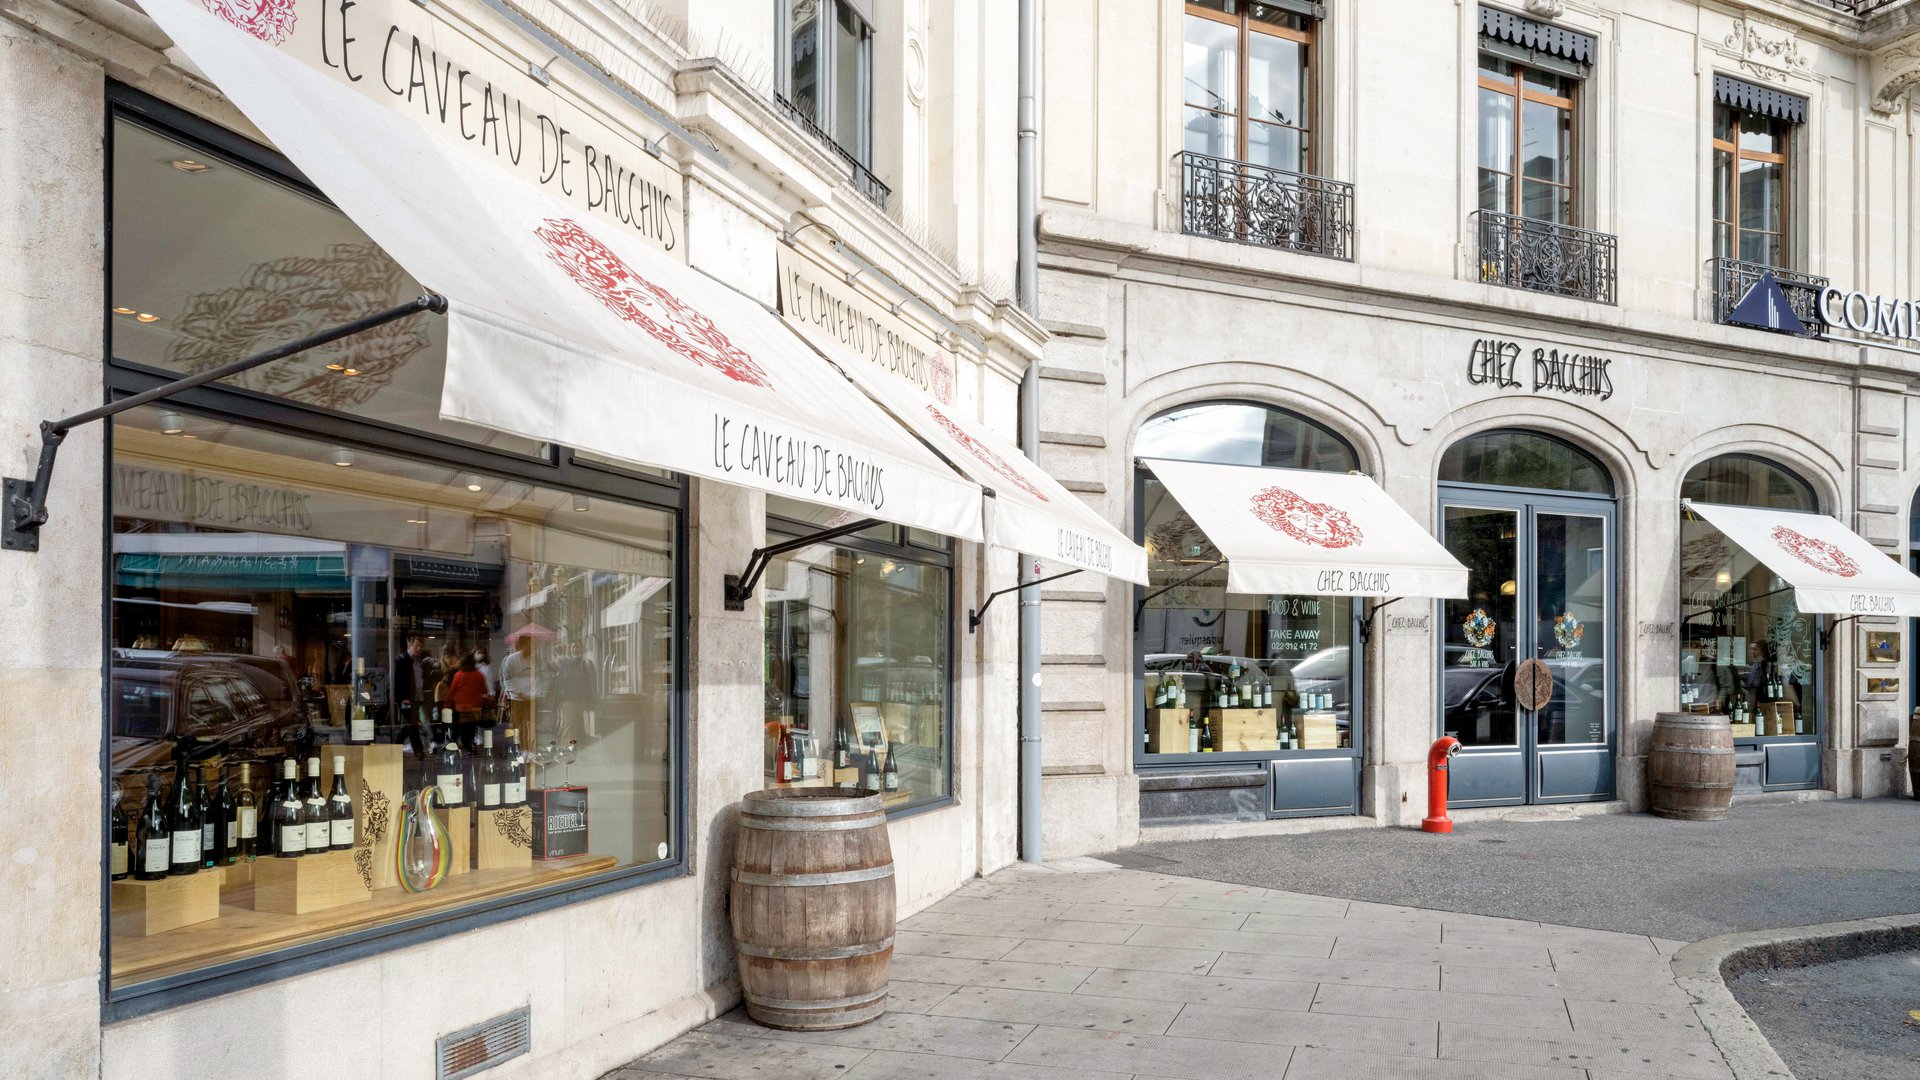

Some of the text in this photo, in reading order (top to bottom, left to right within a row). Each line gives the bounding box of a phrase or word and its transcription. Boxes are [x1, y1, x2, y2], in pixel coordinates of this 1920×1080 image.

[322, 0, 675, 251] LE CAVEAU DE BACCHUS
[787, 266, 928, 391] LE CAVEAU DE BACCHUS
[1467, 338, 1613, 401] CHEZ BACCHUS
[714, 413, 884, 510] LE CAVEAU DE BACCHUS
[1057, 527, 1064, 558] LE
[1065, 530, 1087, 563] CAVEAU
[1087, 537, 1095, 567] DE
[1317, 570, 1390, 593] CHEZ BACCHUS
[1267, 599, 1322, 616] FOOD & WINE
[1692, 591, 1710, 609] CHEZ
[1850, 594, 1896, 613] CHEZ BACCHUS
[1391, 616, 1405, 628] CHEZ
[1268, 629, 1320, 640] TAKE AWAY
[1700, 637, 1717, 646] TAKE
[1271, 642, 1318, 650] 022 312 41 72
[547, 813, 578, 831] RIEDEL
[548, 848, 564, 857] vinum
